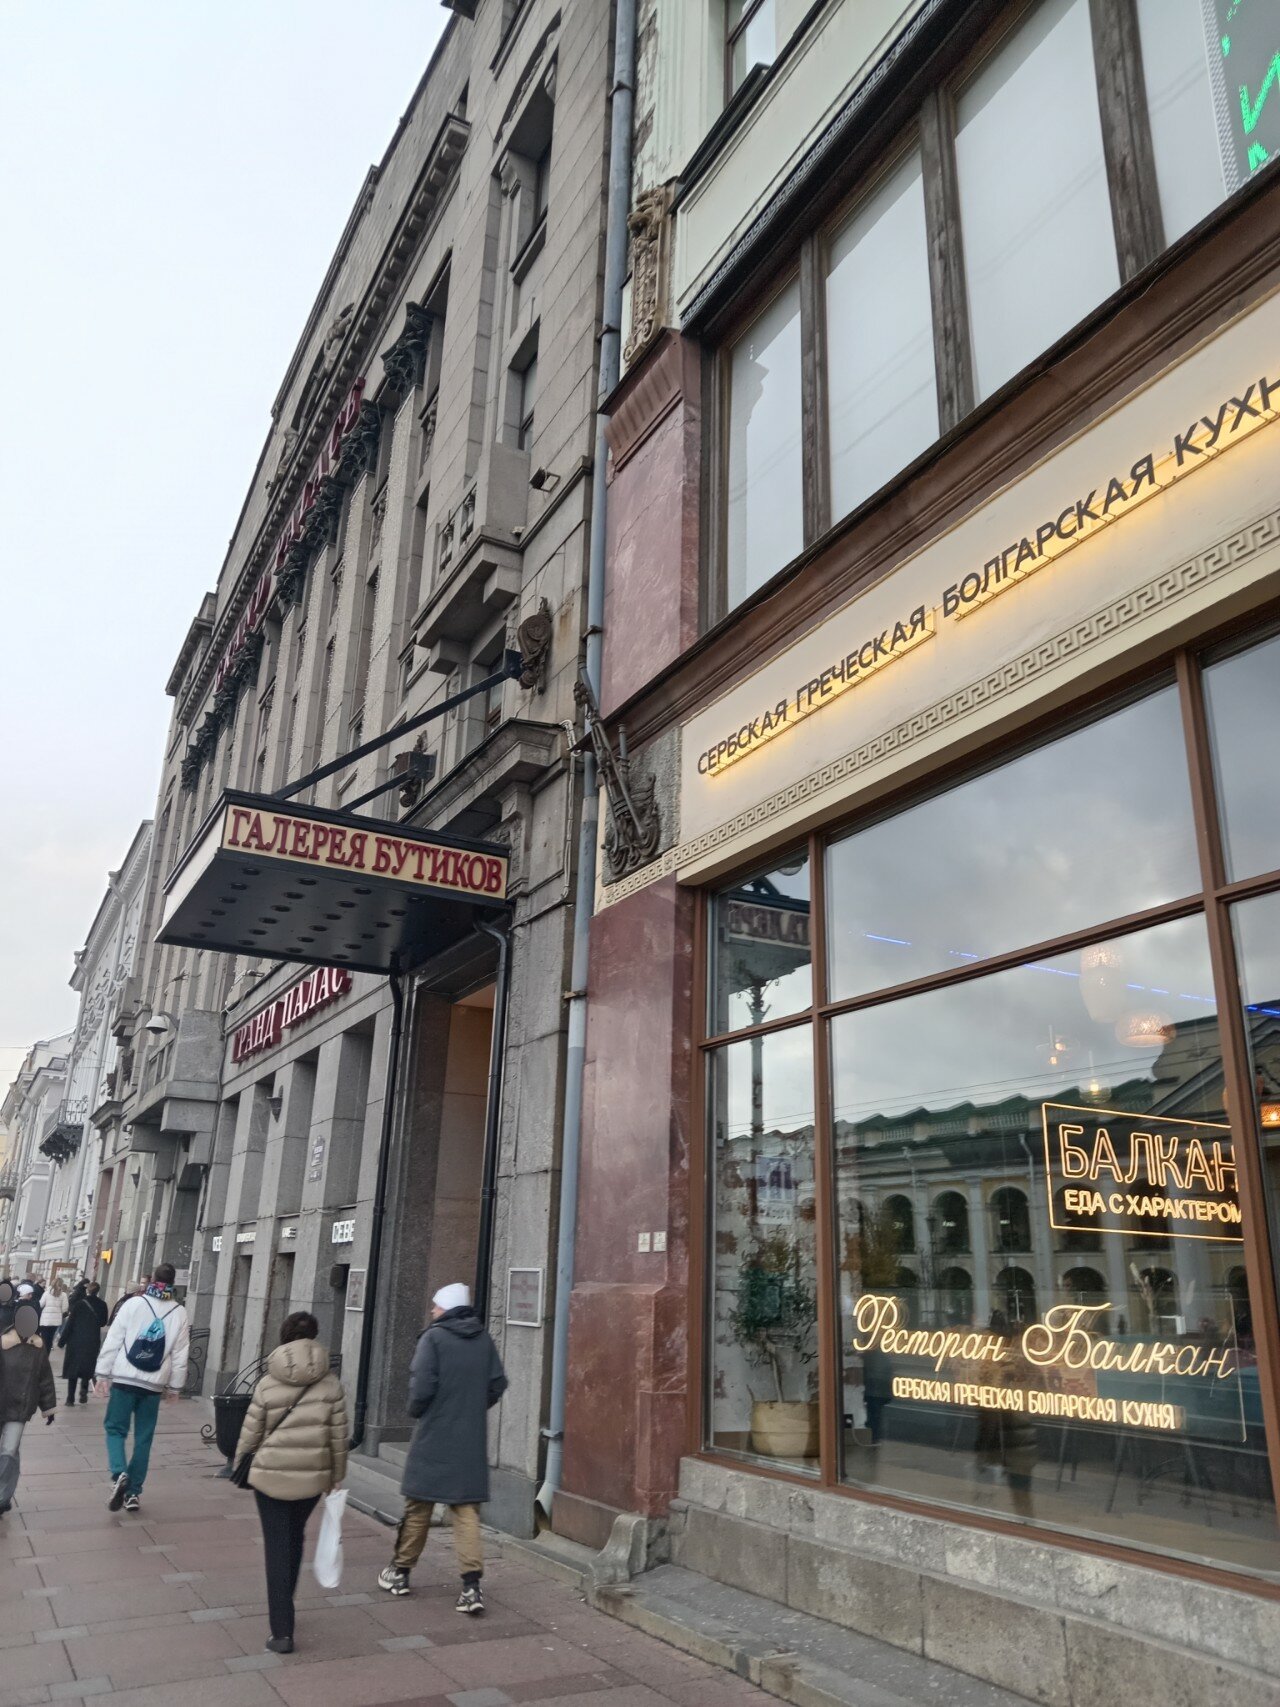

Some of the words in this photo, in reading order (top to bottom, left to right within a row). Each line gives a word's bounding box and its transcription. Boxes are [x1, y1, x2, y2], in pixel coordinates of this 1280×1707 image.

[697, 699, 787, 775] СЕРБСКАЯ
[796, 605, 926, 713] ГРЕЧЕСКАЯ
[942, 453, 1156, 619] БОЛГАРСКАЯ
[228, 808, 368, 869] ГАЛЕРЕЯ
[371, 836, 502, 893] БУТИКОВ
[280, 966, 347, 1029] ПАЛАС
[1058, 1123, 1239, 1193] БАЛКАН
[1064, 1189, 1107, 1216] ЕДА
[1108, 1193, 1125, 1215] С
[1125, 1194, 1242, 1224] ХАРАКТЕРОМ
[852, 1294, 1006, 1373] Ресторан
[1021, 1302, 1236, 1380] Балкан
[892, 1377, 950, 1403] СЕРБСКАЯ
[953, 1383, 1024, 1412] ГРЕЧЕСКАЯ
[1027, 1390, 1117, 1423] БОЛГАРСКАЯ
[1121, 1400, 1176, 1430] КУХНЯ
